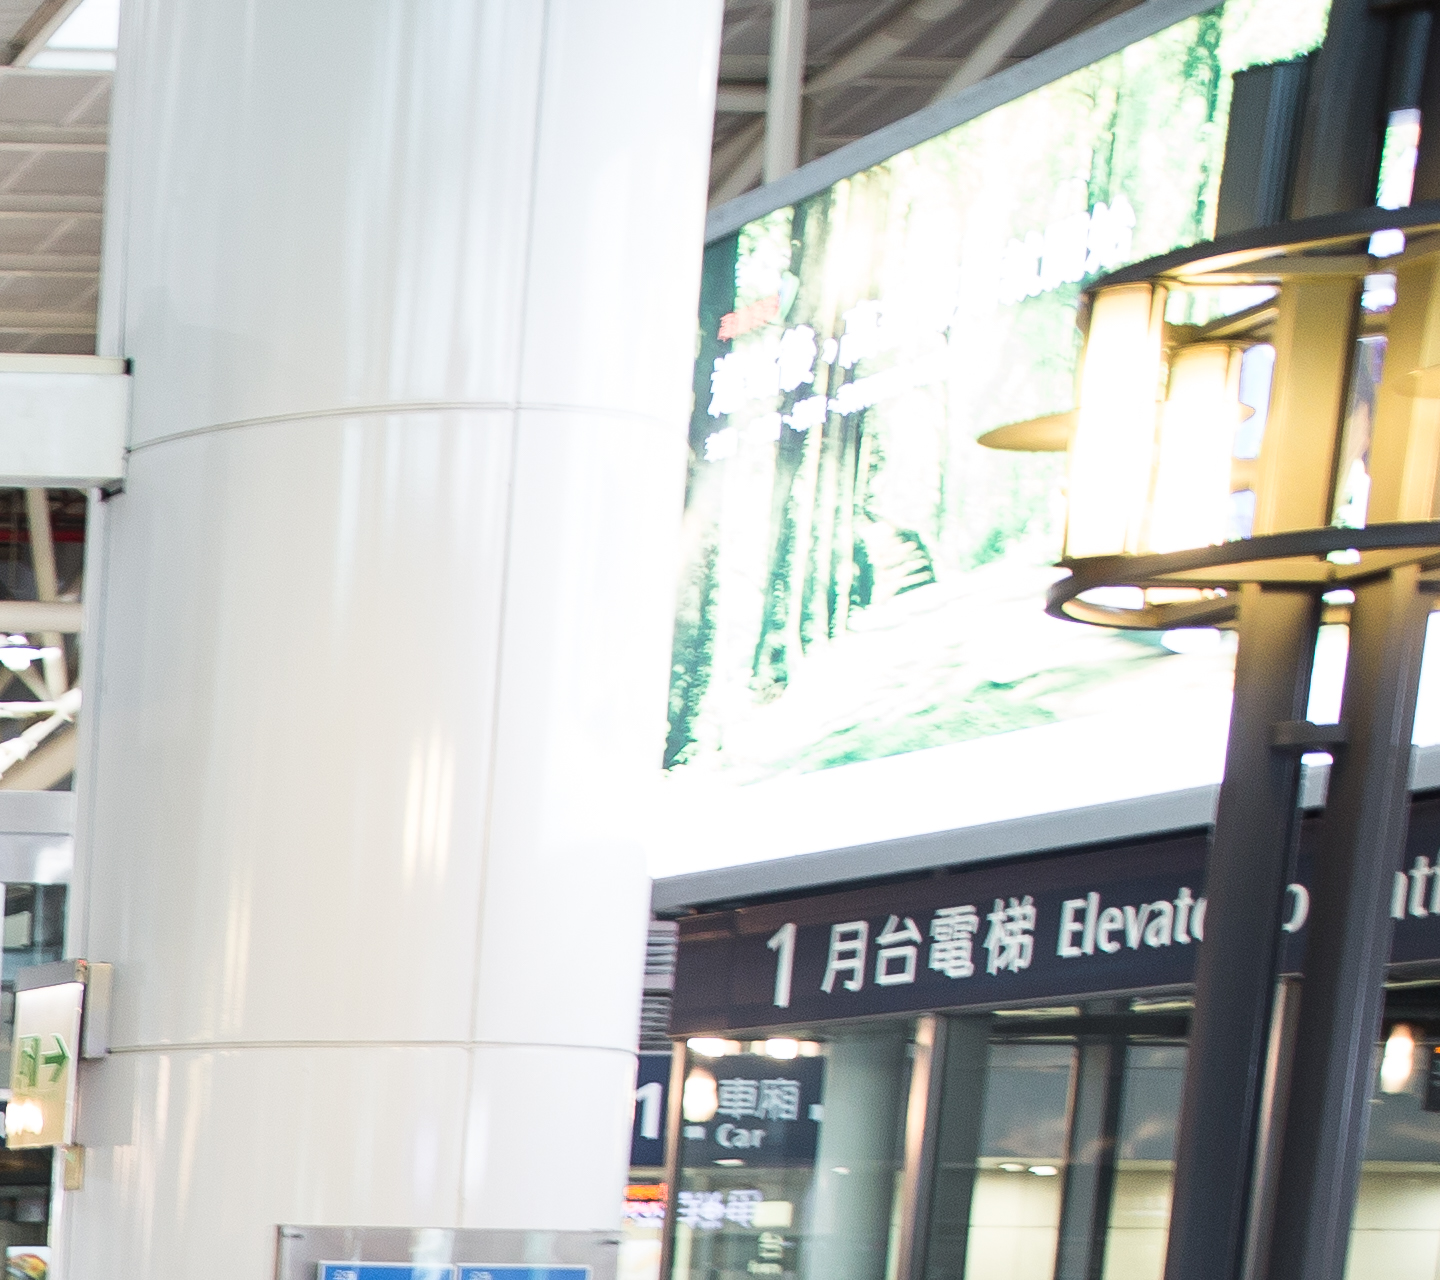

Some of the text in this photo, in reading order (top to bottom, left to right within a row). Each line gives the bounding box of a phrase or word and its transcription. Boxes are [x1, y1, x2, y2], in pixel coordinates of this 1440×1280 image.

[767, 922, 798, 1008] 1
[821, 895, 1036, 996] 月台電梯
[636, 1082, 663, 1140] 1
[714, 1123, 767, 1148] Car
